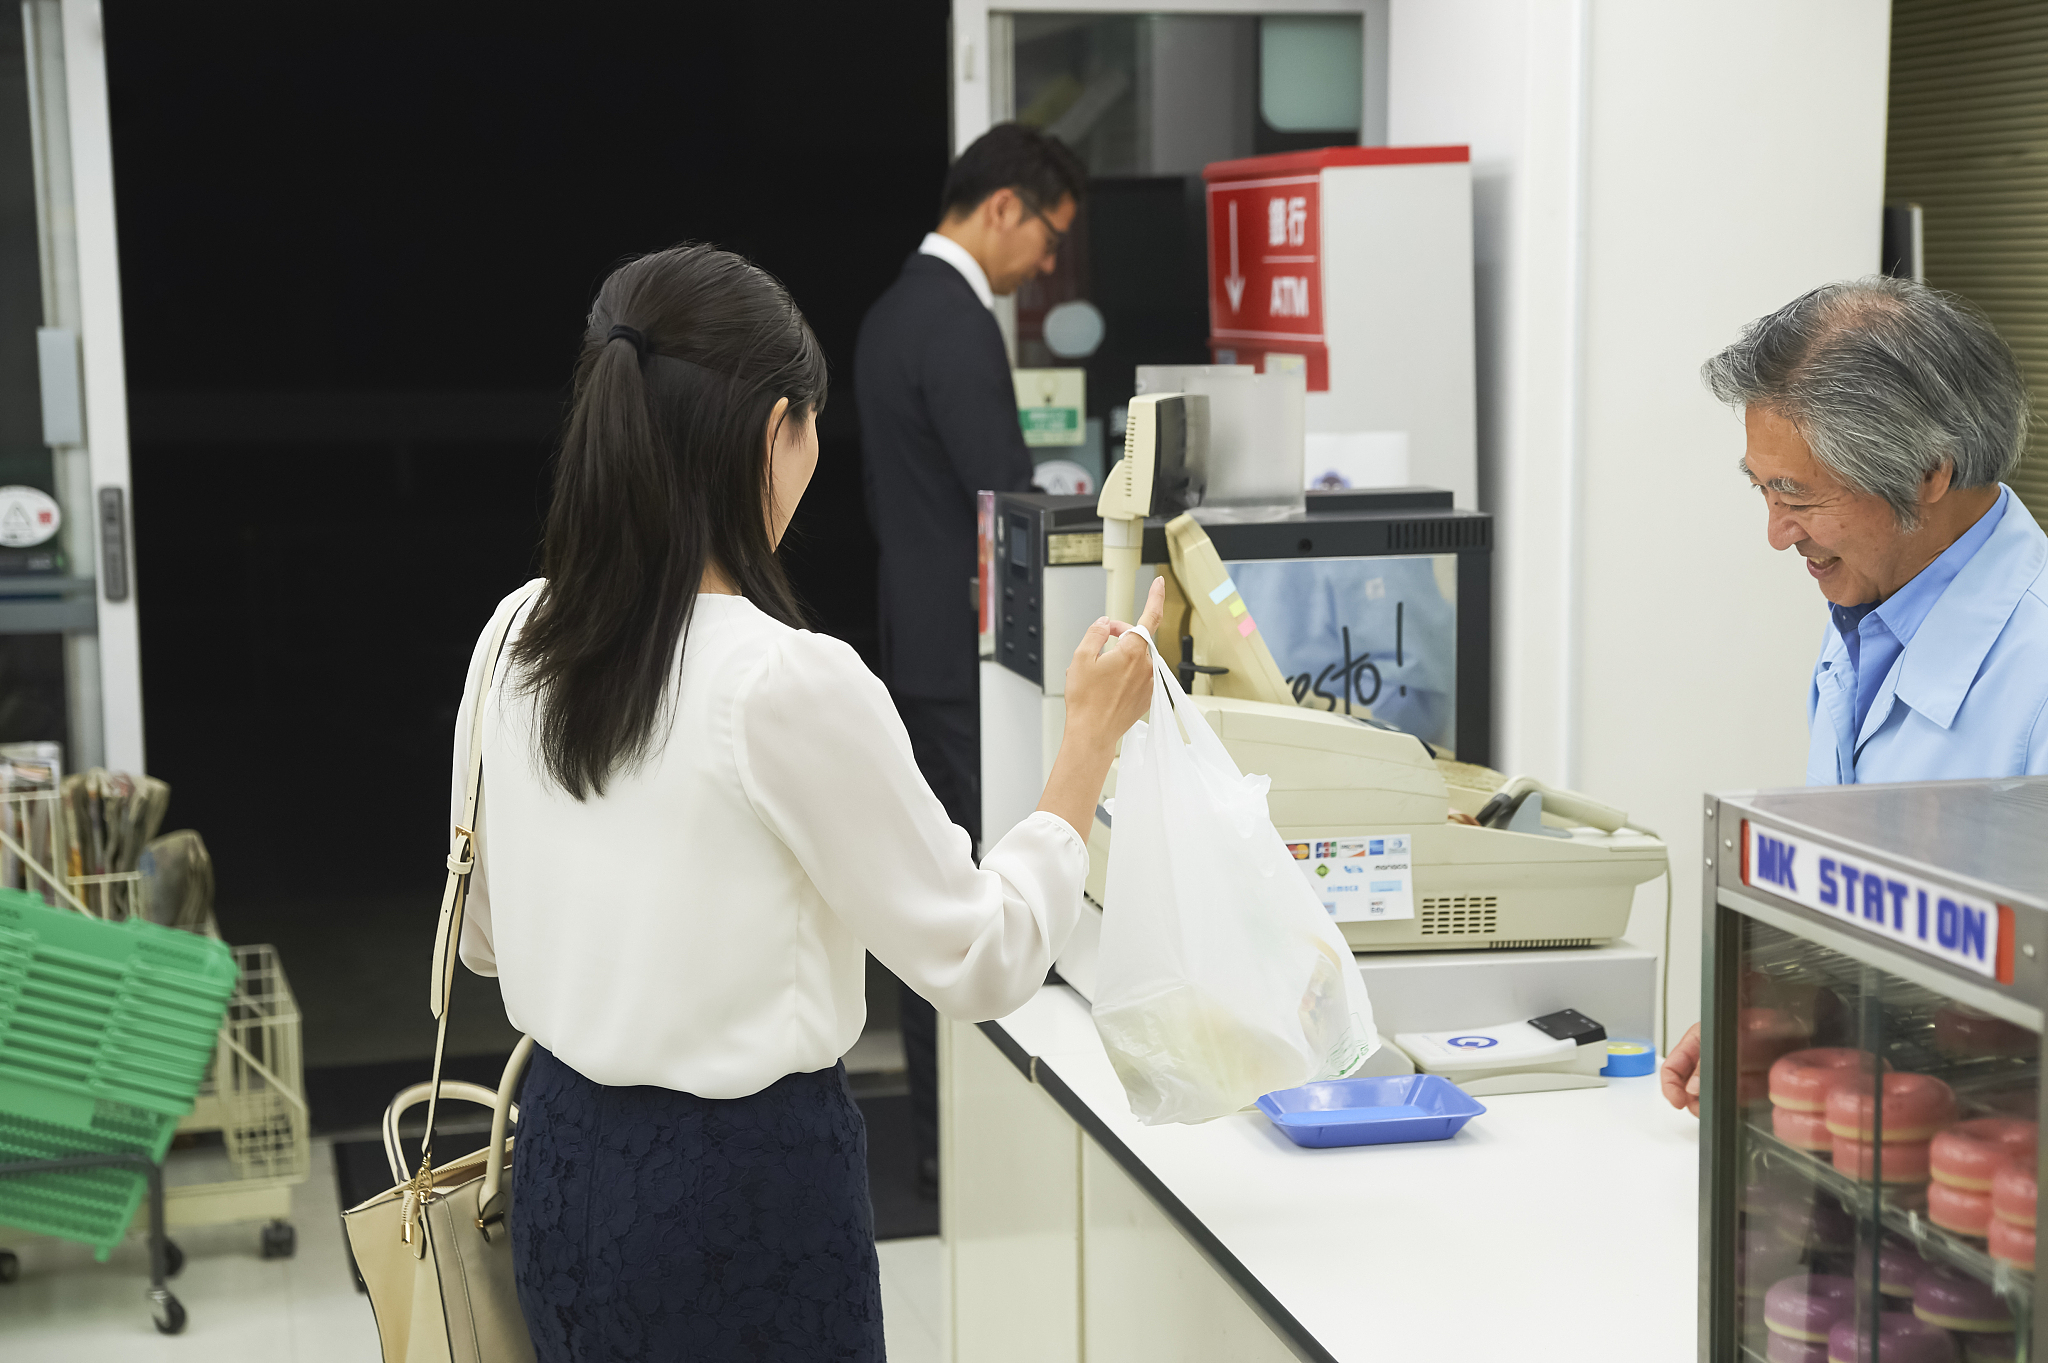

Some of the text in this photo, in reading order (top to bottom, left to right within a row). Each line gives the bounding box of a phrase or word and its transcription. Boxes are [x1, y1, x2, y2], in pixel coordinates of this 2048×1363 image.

[1268, 196, 1307, 247] 銀行
[1269, 275, 1310, 318] ATM
[1286, 601, 1407, 715] esto!
[1757, 832, 1987, 961] MK STATION
